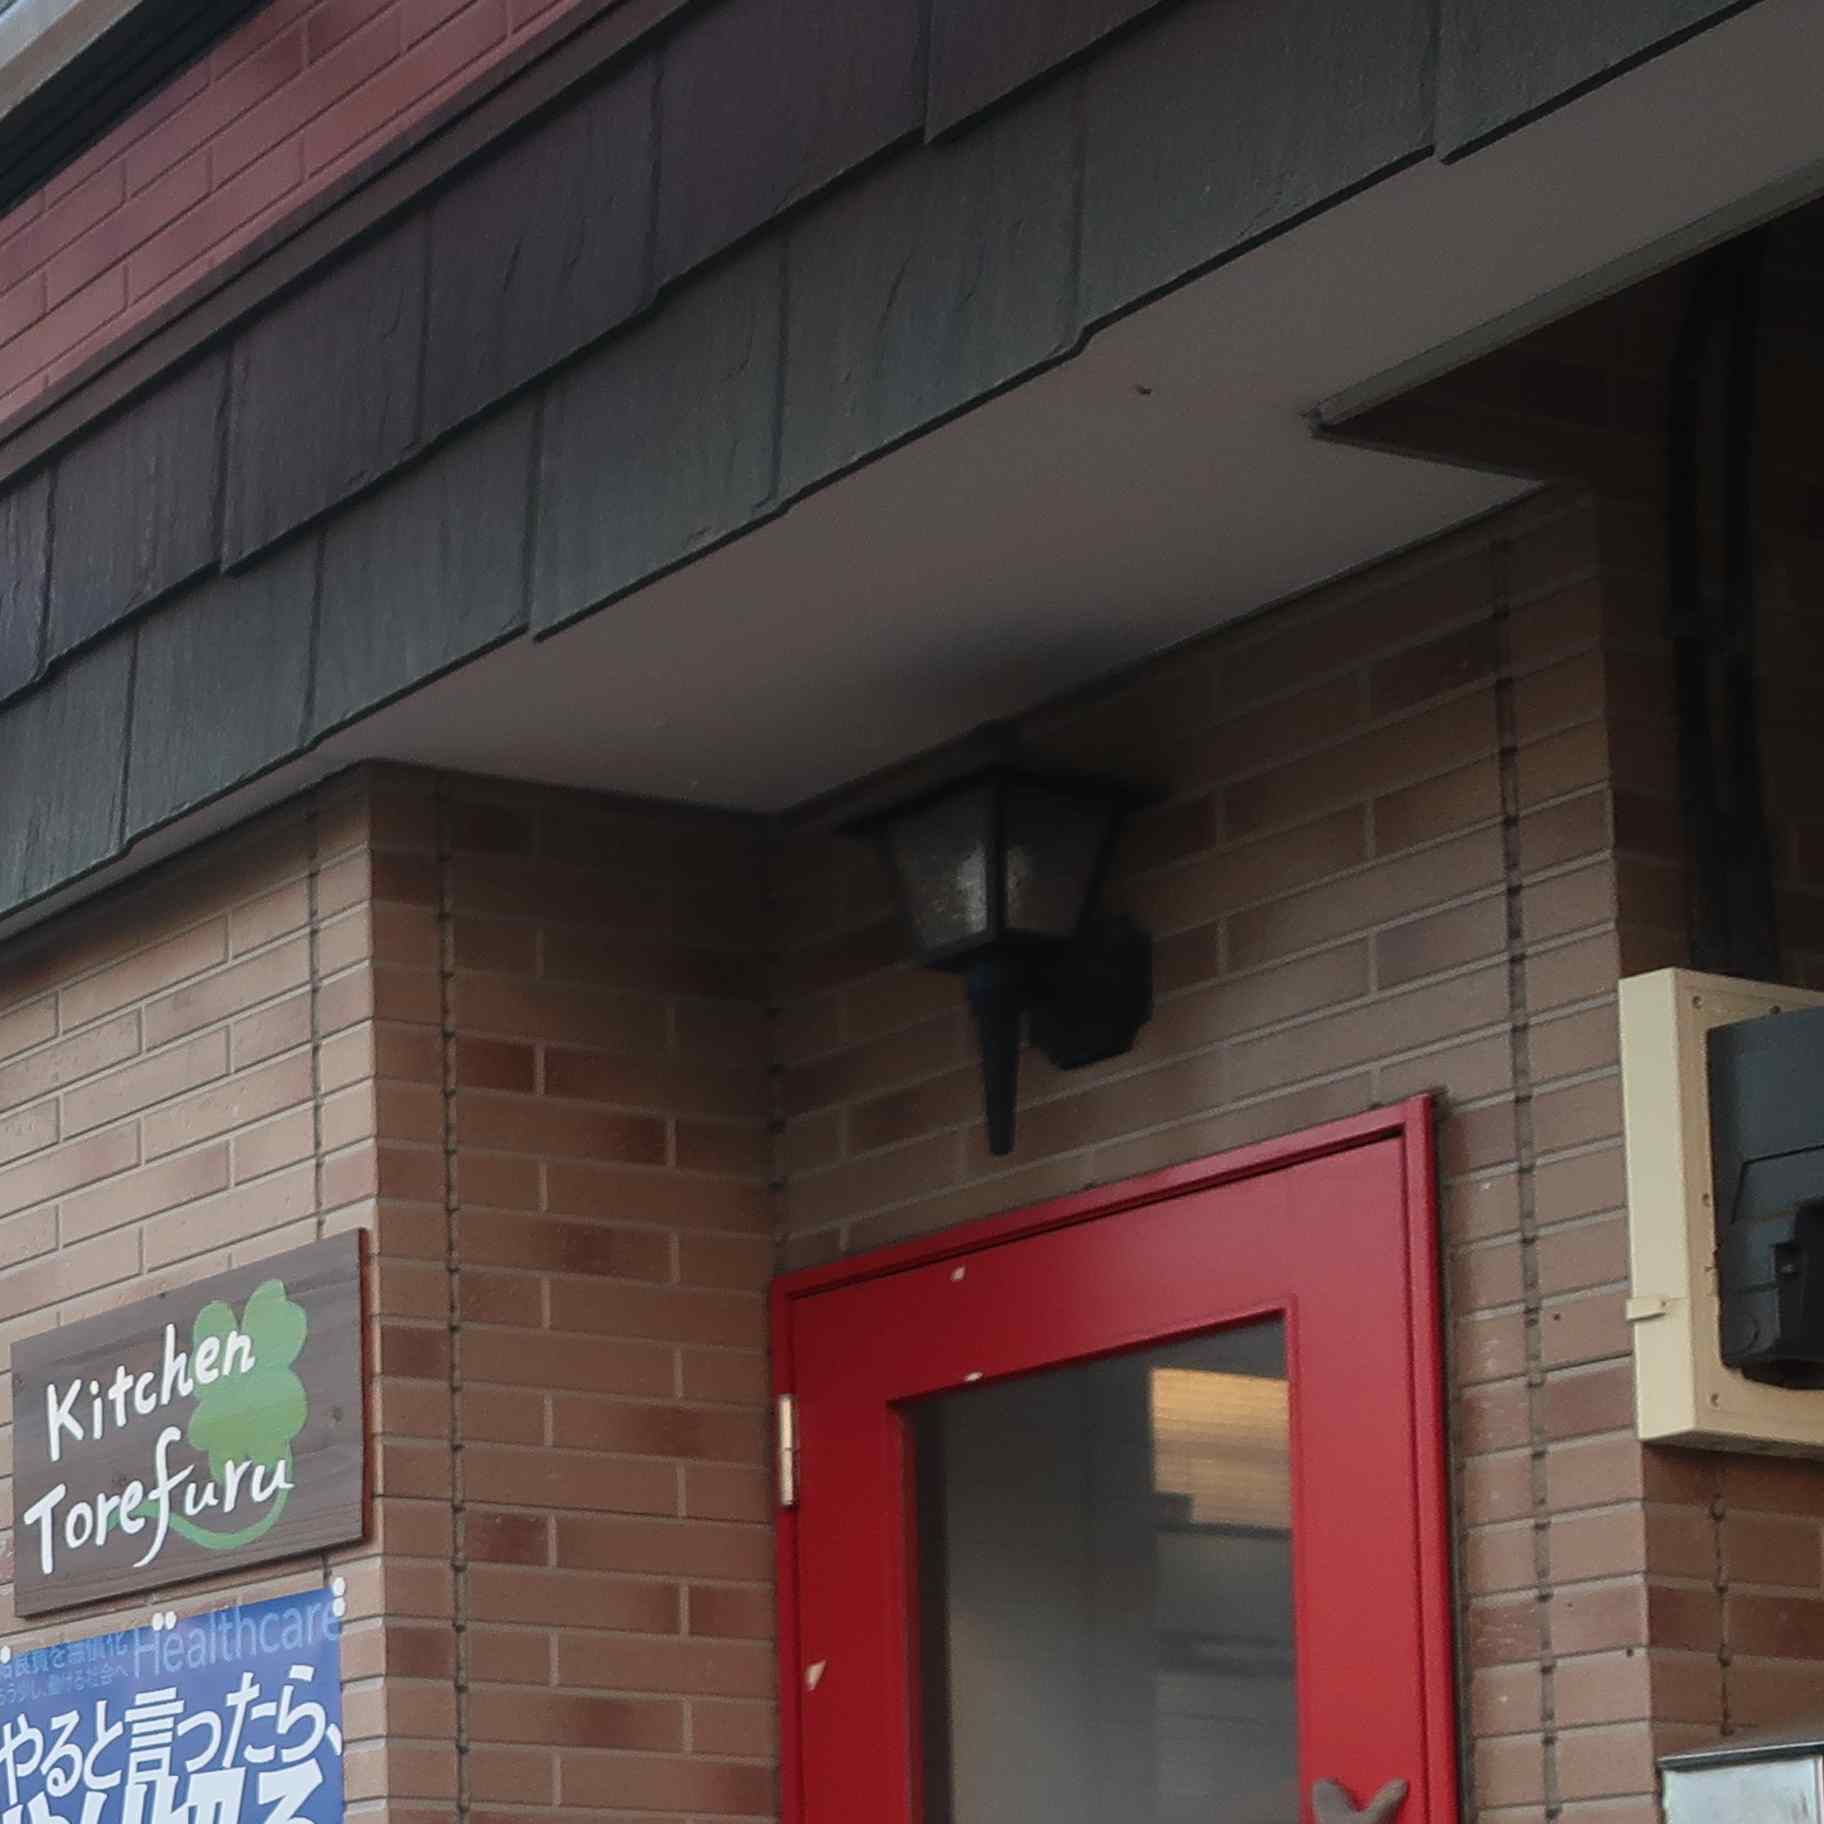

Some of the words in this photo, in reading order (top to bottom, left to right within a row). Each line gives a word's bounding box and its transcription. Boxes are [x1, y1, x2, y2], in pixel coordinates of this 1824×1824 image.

[46, 1323, 256, 1462] Kitchen
[23, 1427, 294, 1574] Torefuru
[132, 1602, 340, 1678] Healthcare
